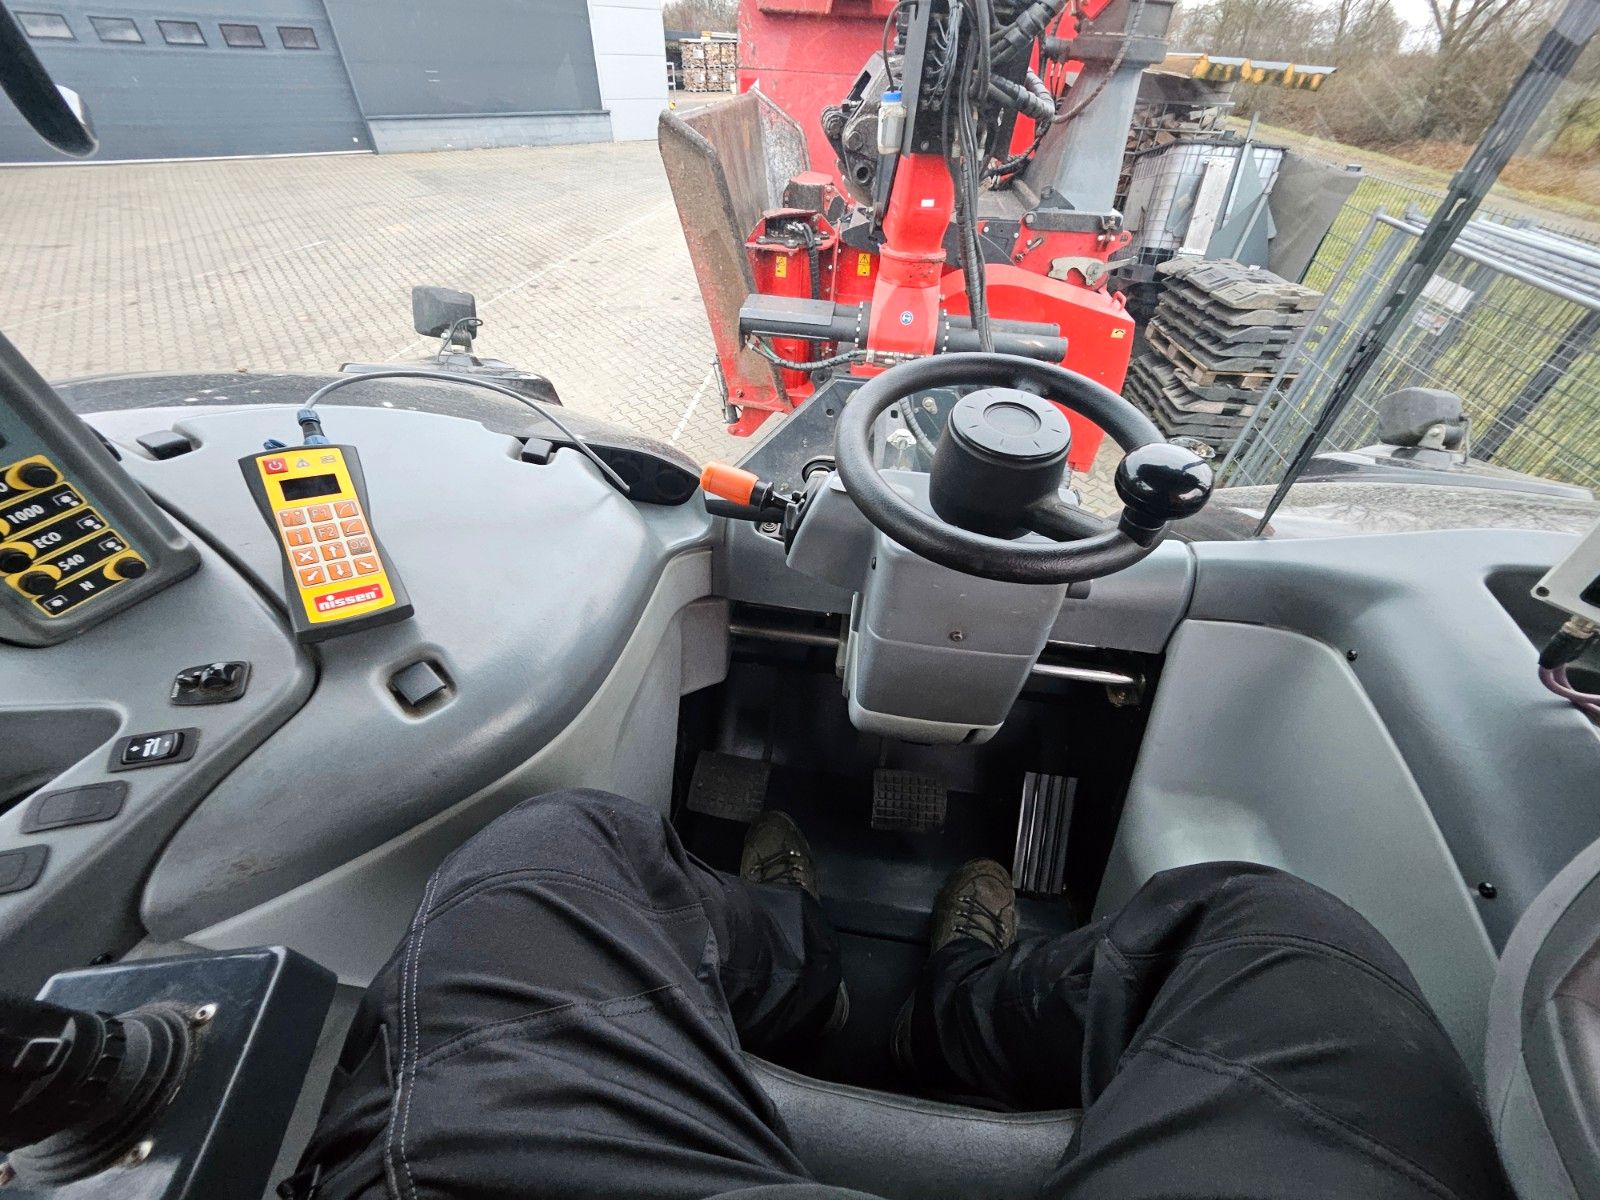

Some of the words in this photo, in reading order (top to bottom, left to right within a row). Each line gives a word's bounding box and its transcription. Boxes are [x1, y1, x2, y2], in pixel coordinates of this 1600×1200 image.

[6, 504, 45, 524] 1000
[318, 525, 336, 537] F2
[32, 531, 62, 549] ECO
[350, 537, 369, 550] OK
[57, 554, 85, 571] 540
[79, 580, 95, 591] N
[318, 590, 377, 611] nissen
